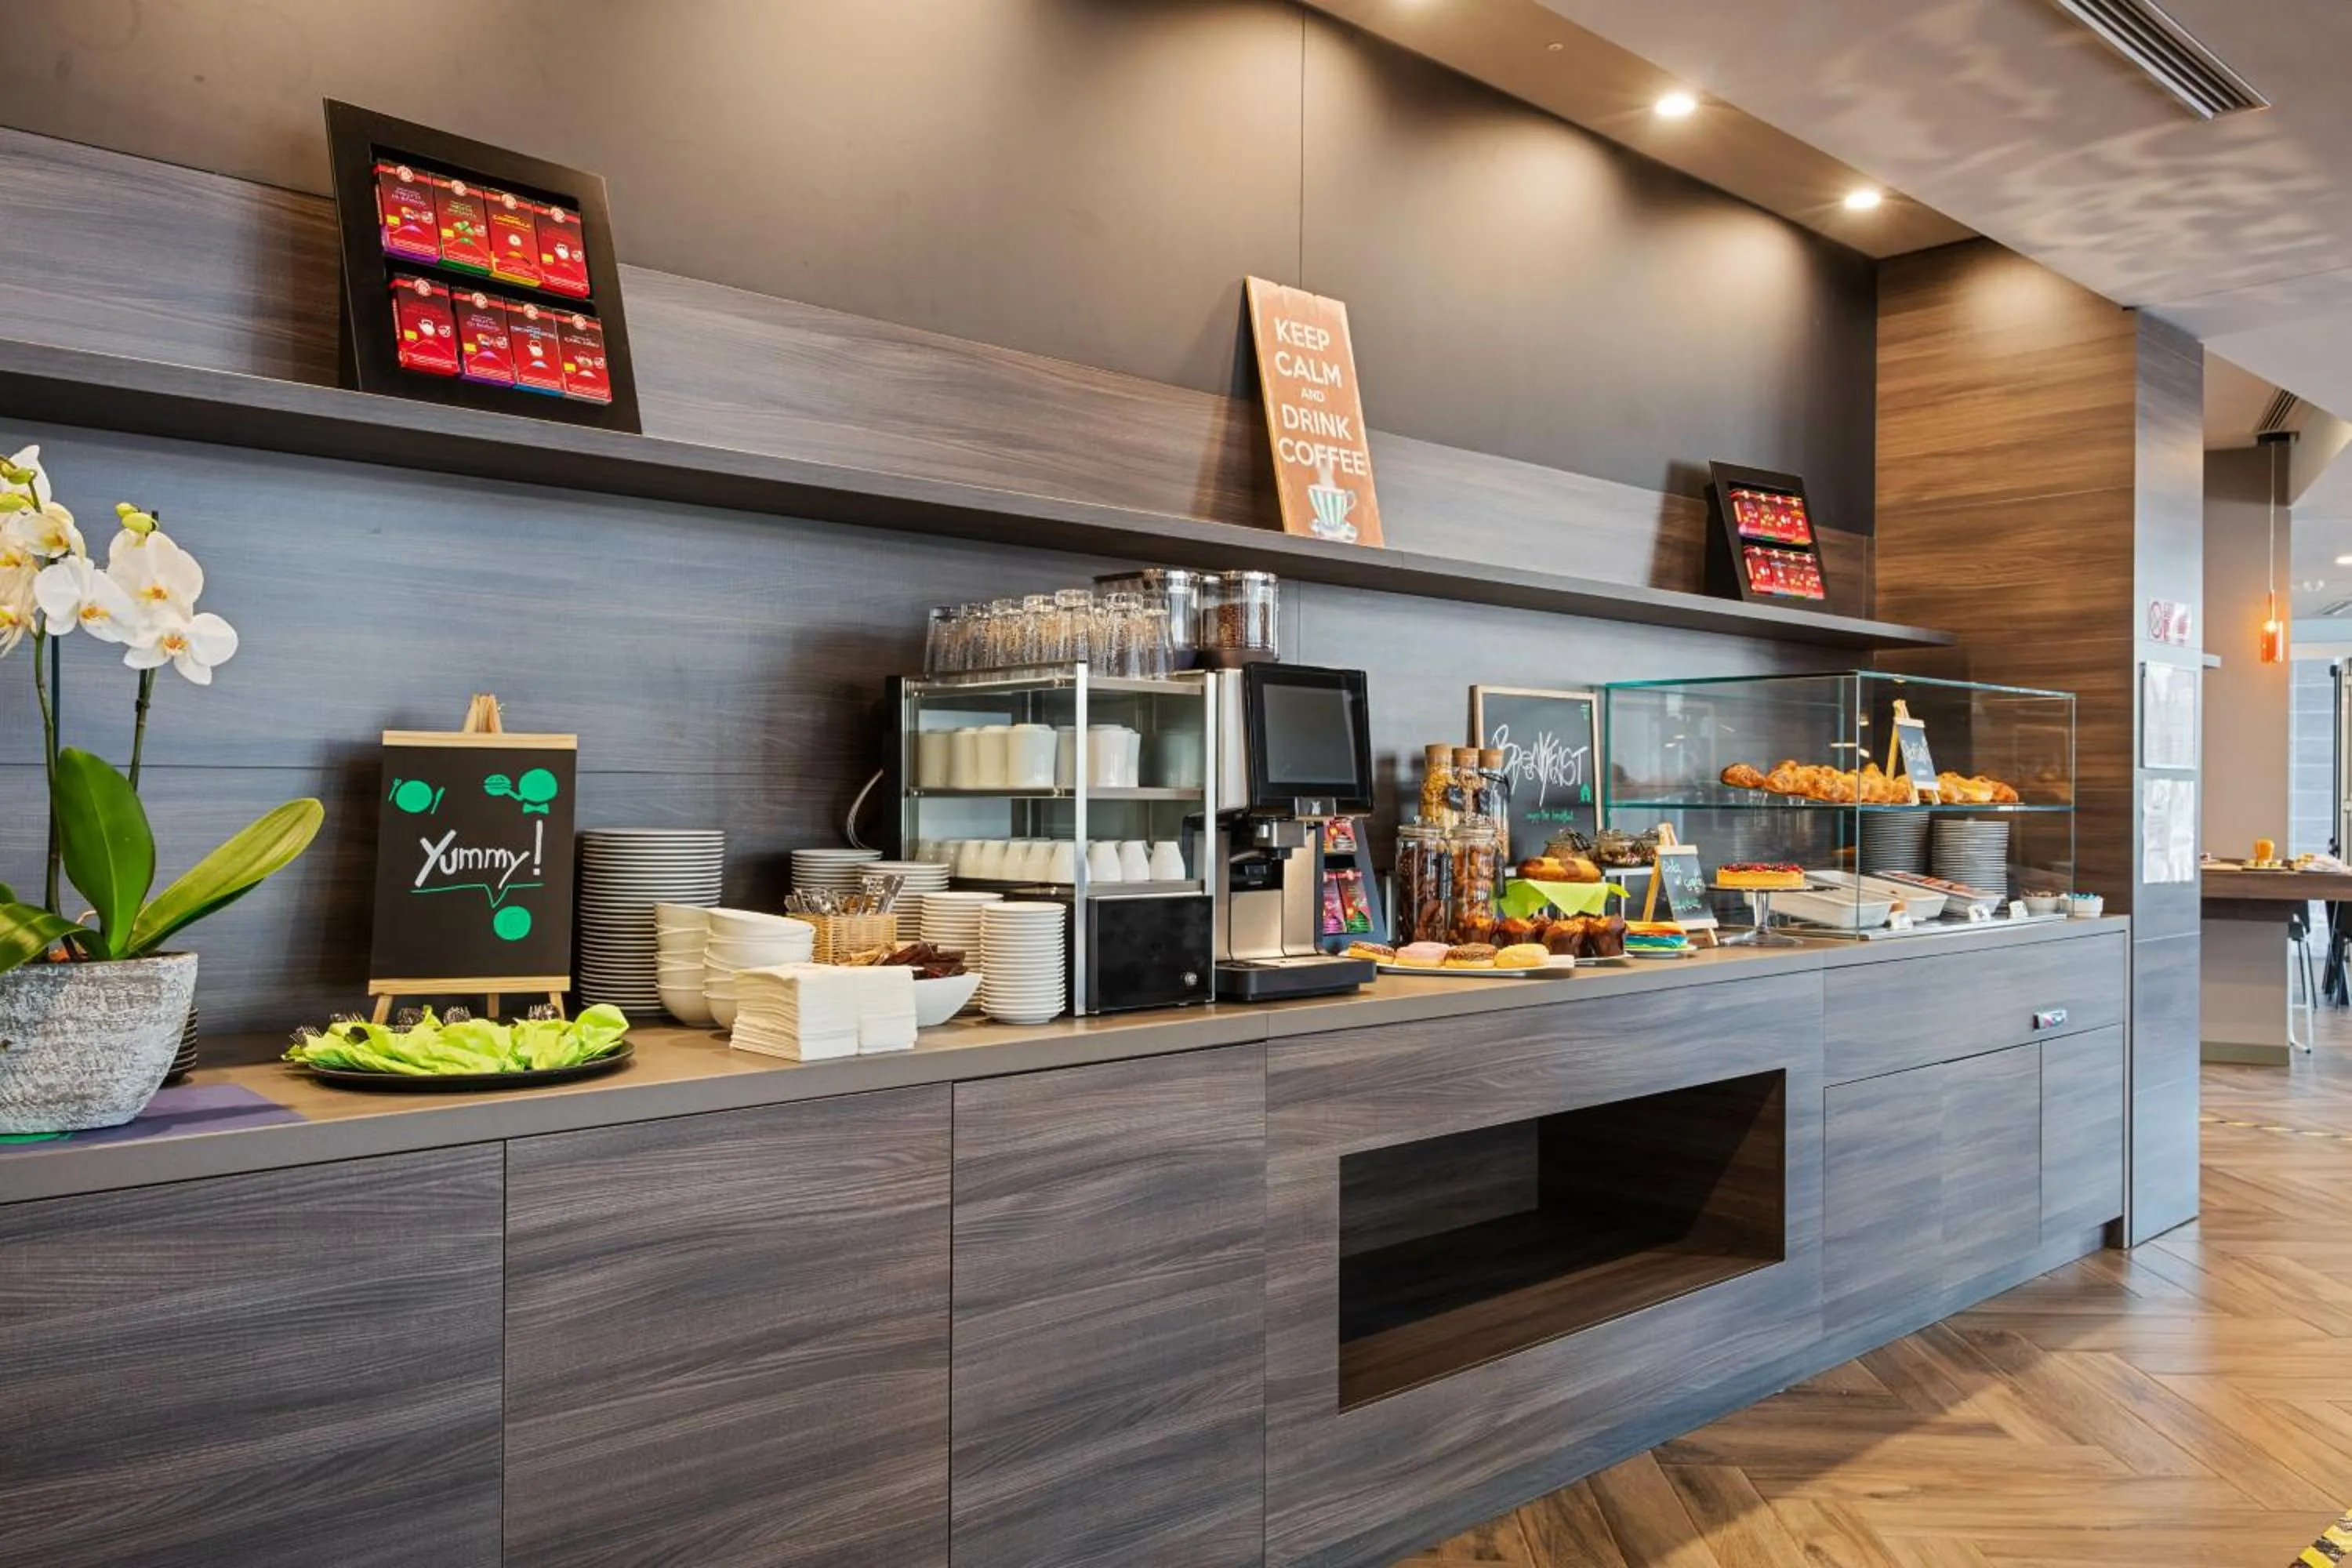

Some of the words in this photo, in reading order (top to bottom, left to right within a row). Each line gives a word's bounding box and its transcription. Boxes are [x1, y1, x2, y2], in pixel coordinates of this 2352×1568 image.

[1273, 317, 1330, 352] KEEP
[1274, 352, 1343, 388] CALM
[1300, 388, 1325, 403] AND
[1281, 403, 1353, 441] DRINK
[1278, 437, 1367, 477] COFFEE
